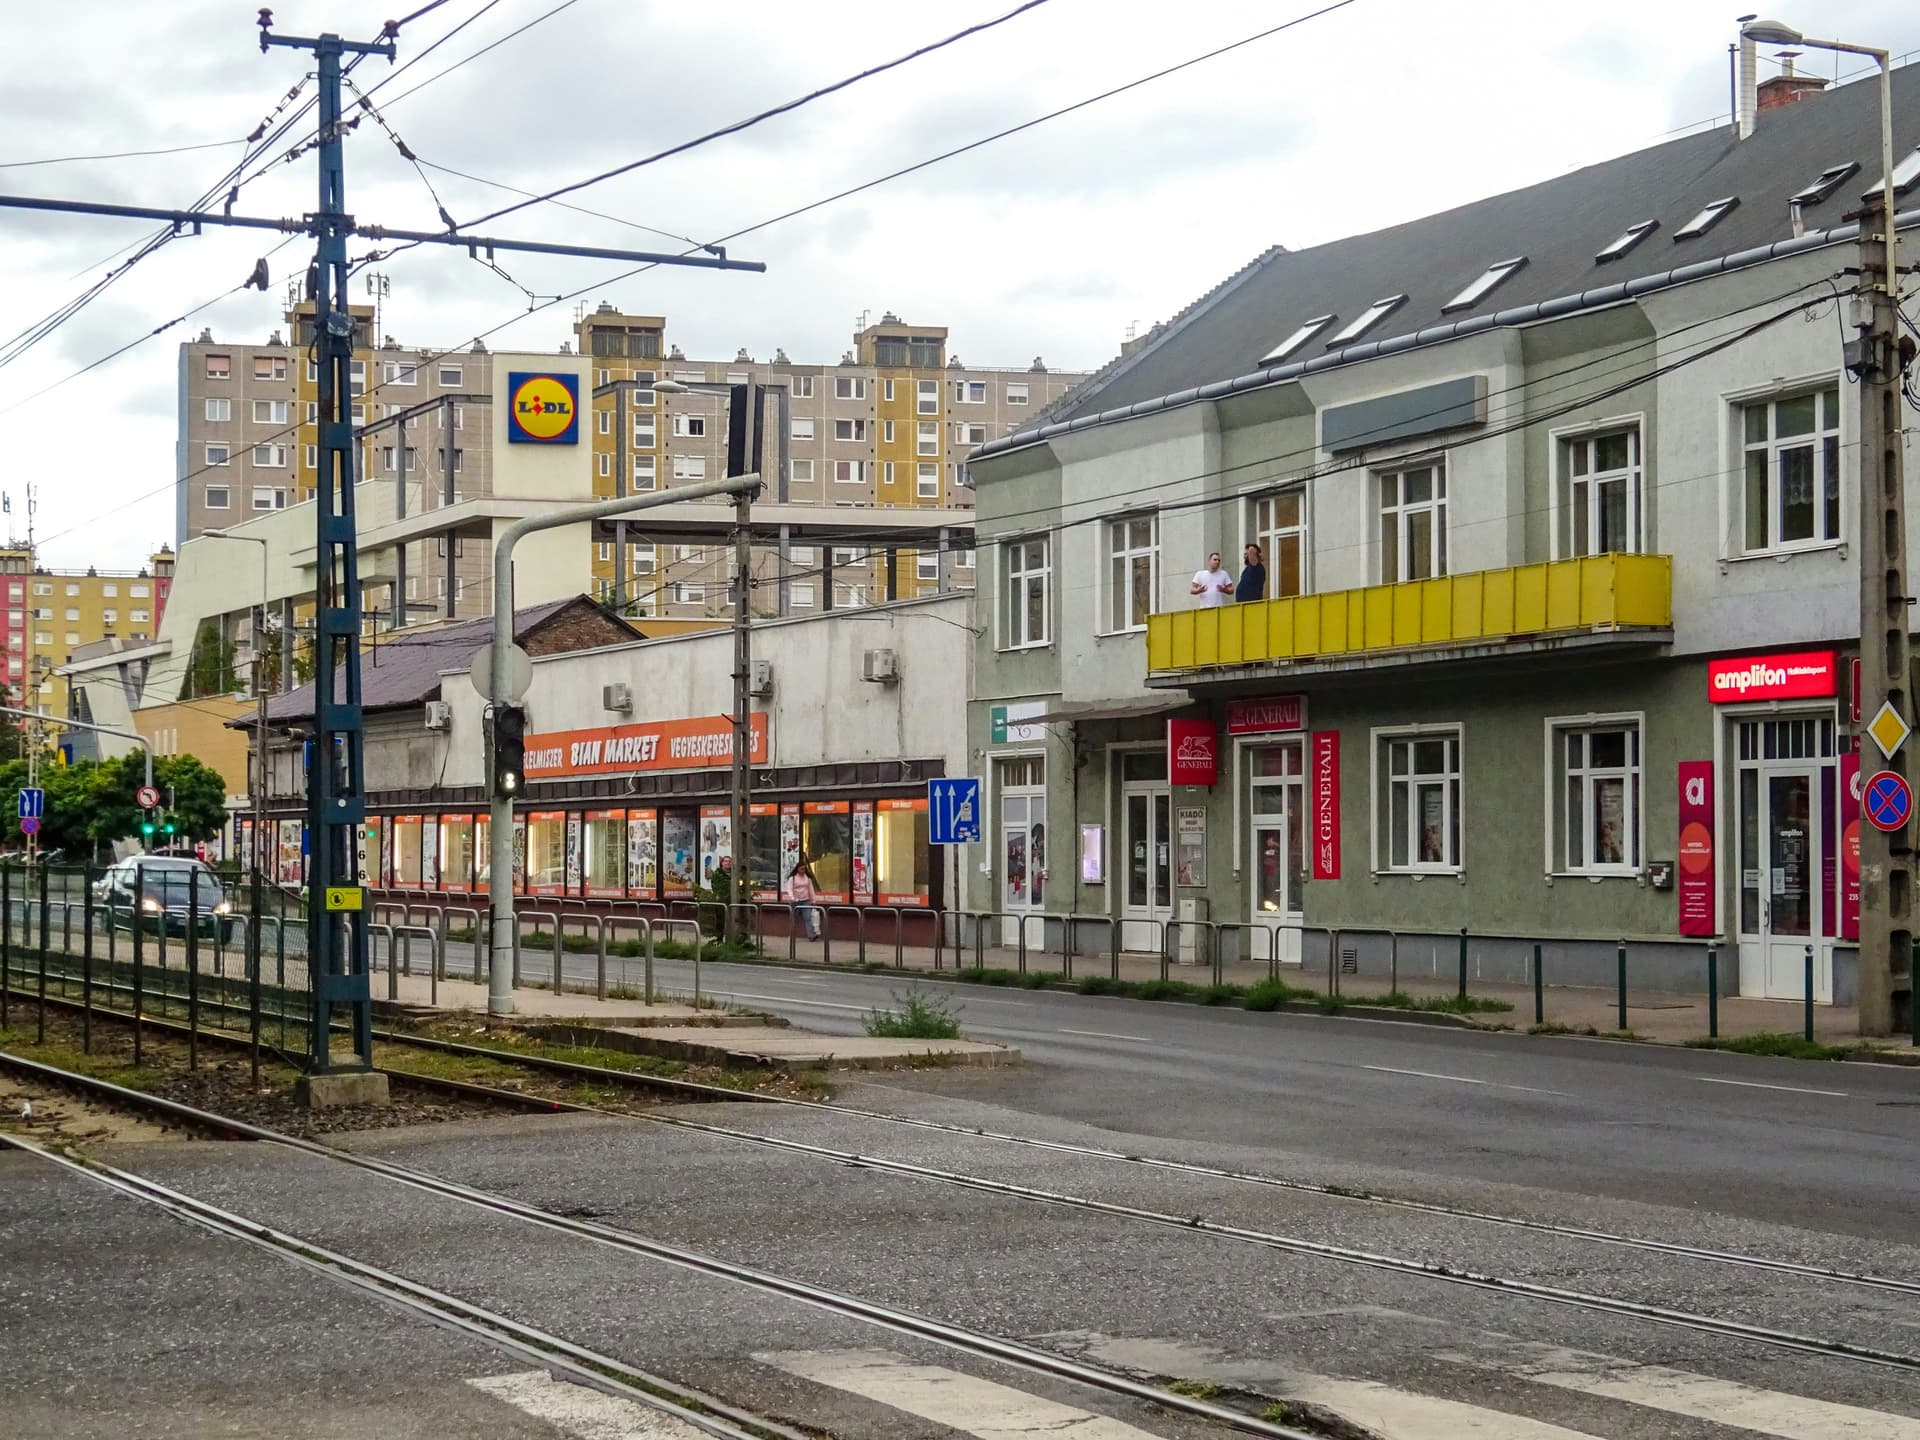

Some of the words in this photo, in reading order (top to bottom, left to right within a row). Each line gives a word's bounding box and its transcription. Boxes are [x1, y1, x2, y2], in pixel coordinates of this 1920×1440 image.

[1714, 664, 1786, 693] amplifon
[1246, 704, 1299, 725] GENERALI
[570, 739, 602, 767] BIAN
[604, 734, 660, 764] MARKET
[1177, 760, 1213, 769] GENERALI
[1320, 737, 1332, 841] GENERALI
